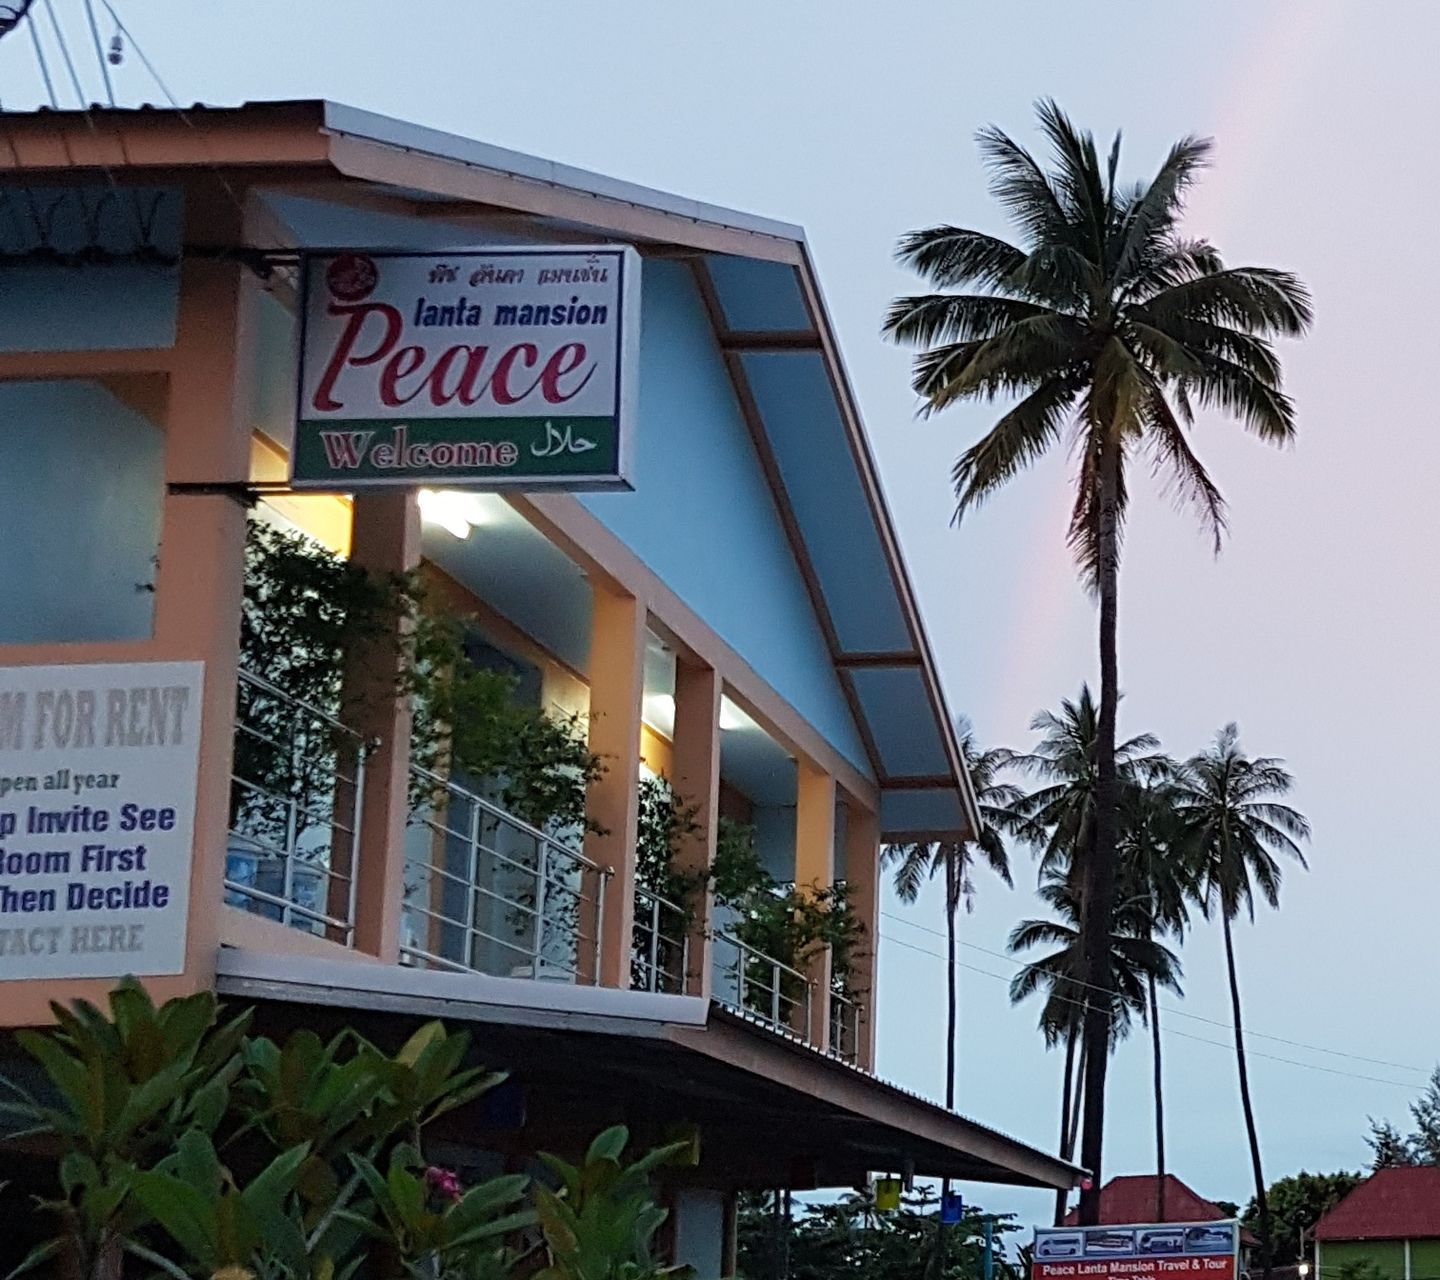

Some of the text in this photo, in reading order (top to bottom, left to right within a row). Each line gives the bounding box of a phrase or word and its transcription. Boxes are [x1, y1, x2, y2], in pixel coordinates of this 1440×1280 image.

[414, 295, 608, 327] lanta mansion
[312, 302, 598, 412] Peace
[319, 426, 519, 469] Welcome
[530, 421, 598, 458] حلال
[34, 688, 96, 751] FOR
[104, 686, 190, 748] RENT
[43, 769, 70, 790] all
[73, 773, 120, 796] year
[28, 804, 110, 835] Invite
[120, 803, 177, 832] See
[81, 843, 147, 873] First
[67, 879, 170, 911] Decide
[70, 924, 145, 954] HERE
[1042, 1258, 1228, 1276] Peace Lanta Mansion Travel & Tour
